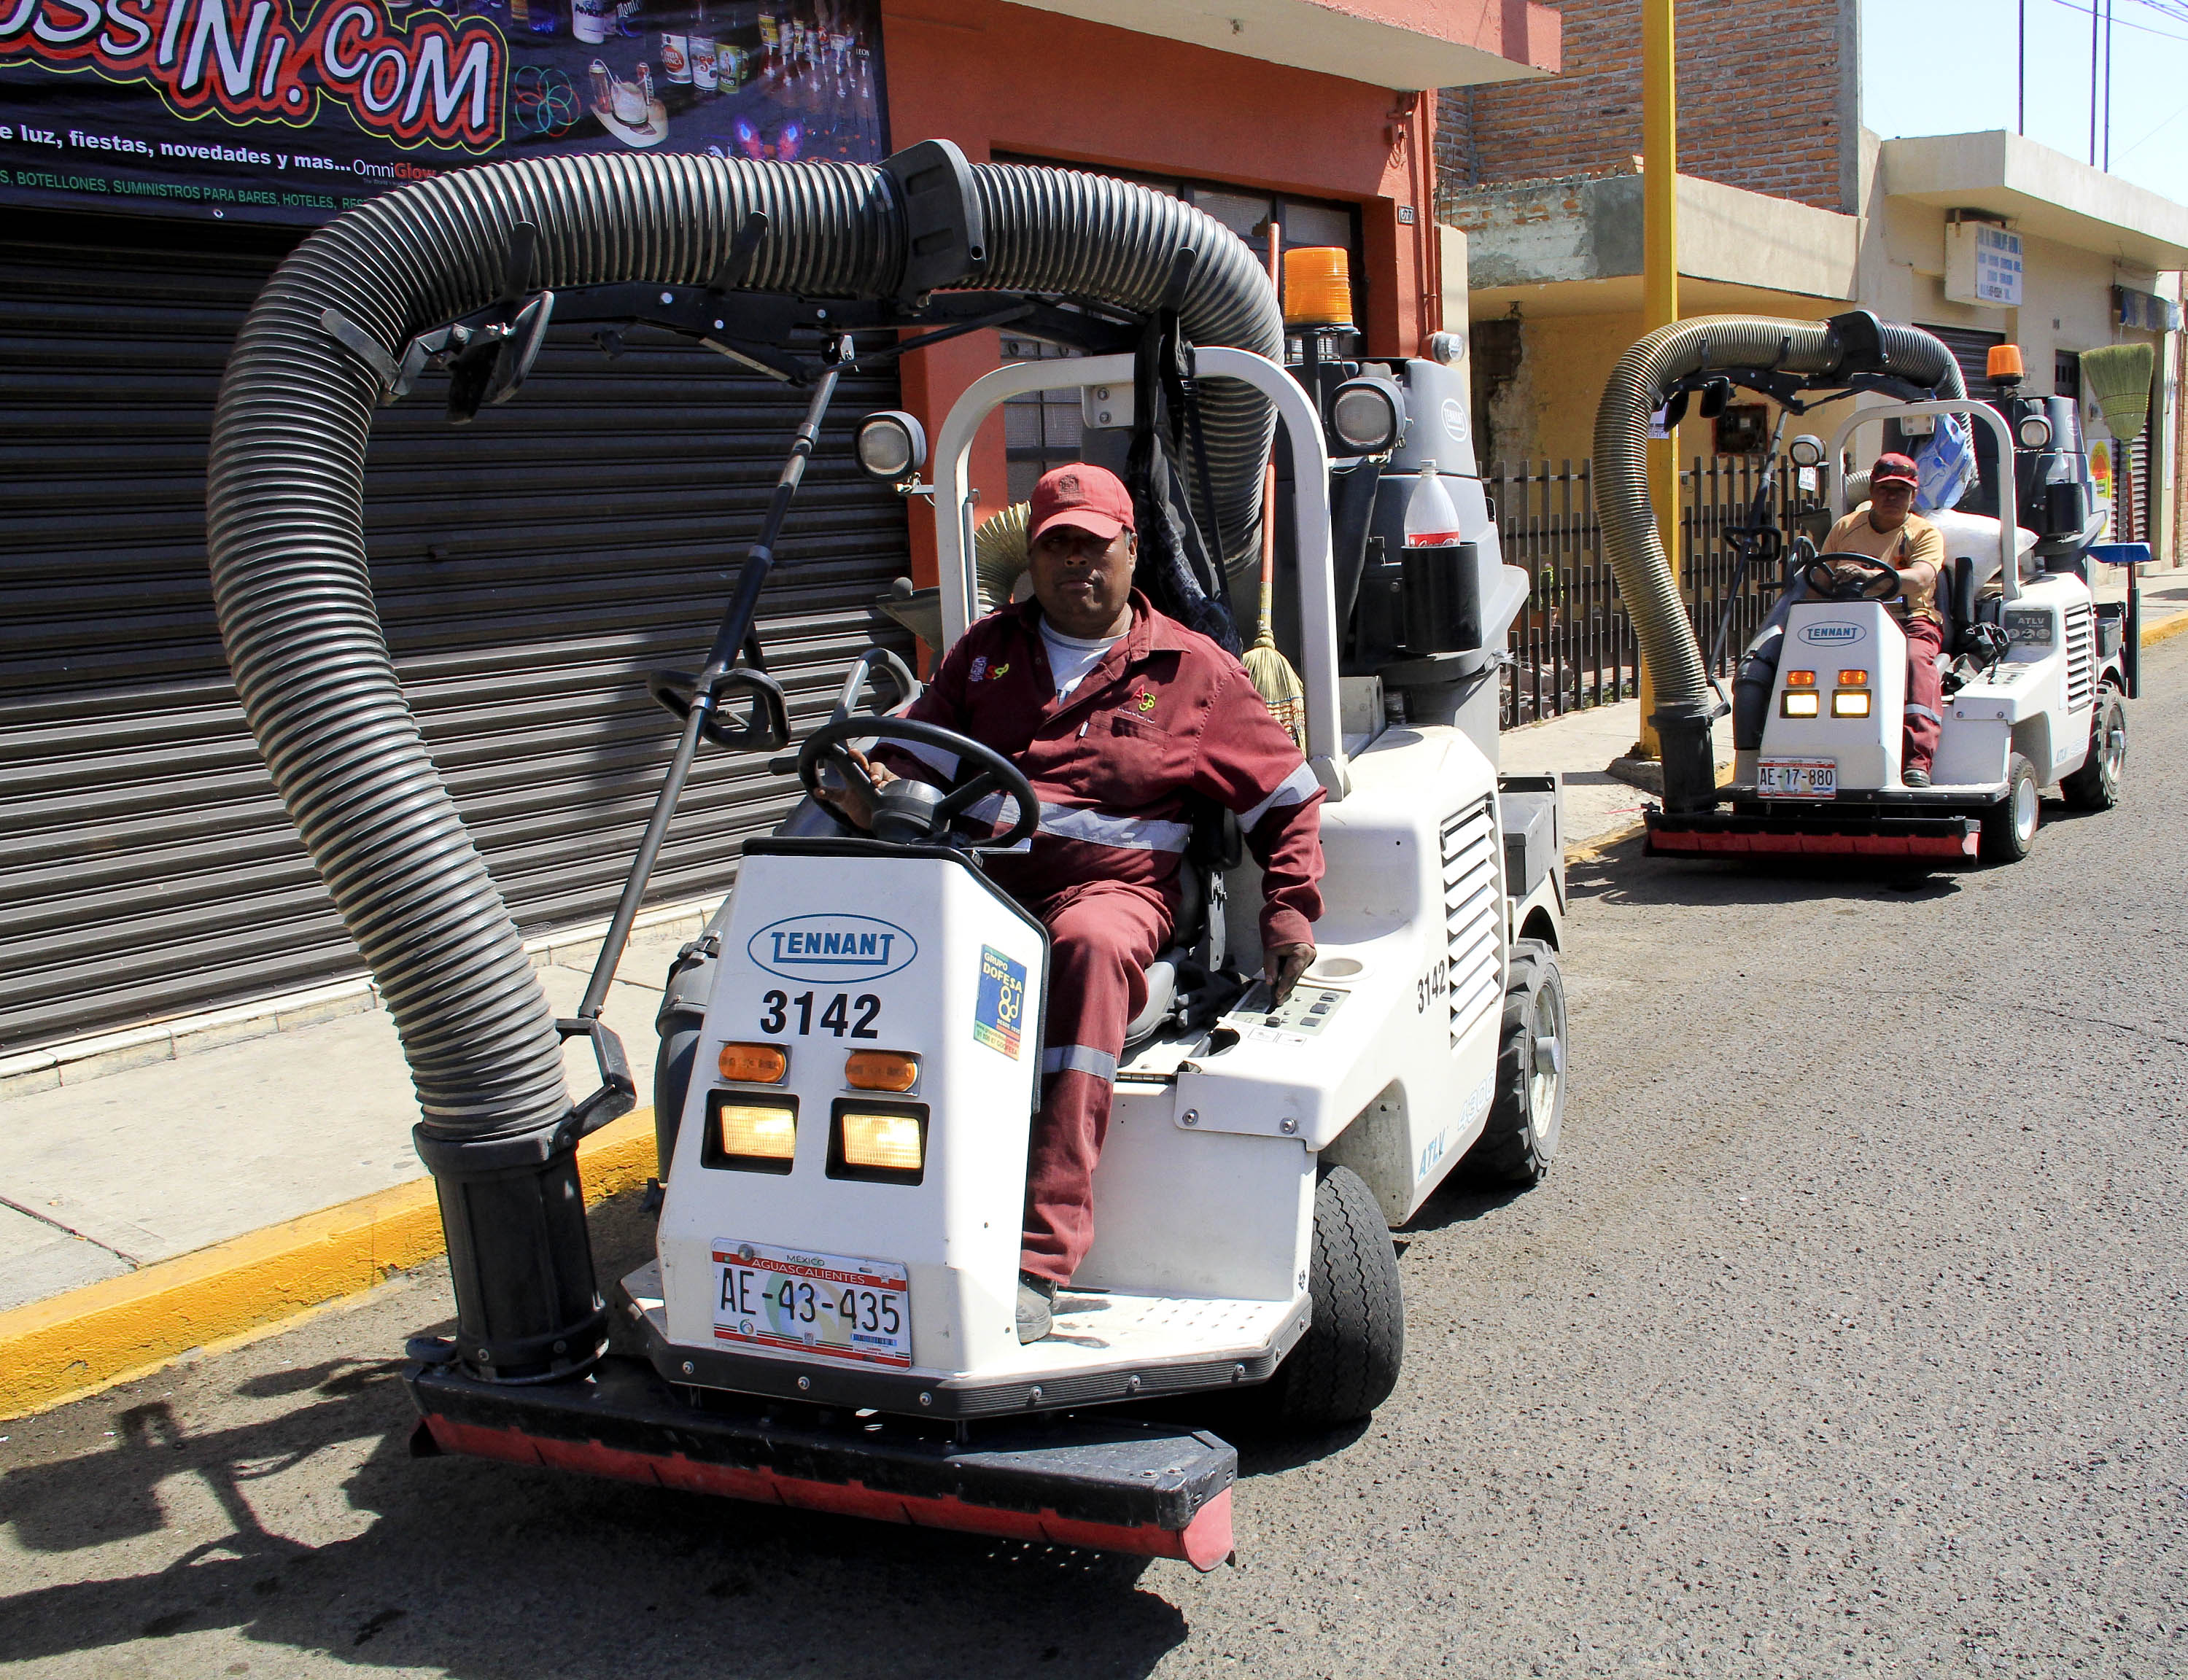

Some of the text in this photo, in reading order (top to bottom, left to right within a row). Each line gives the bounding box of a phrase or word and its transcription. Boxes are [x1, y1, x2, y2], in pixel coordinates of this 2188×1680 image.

[20, 124, 62, 149] luz,
[69, 129, 154, 158] fiestas,
[160, 142, 271, 165] novedades
[276, 153, 288, 169] y
[294, 155, 351, 171] mas...
[17, 171, 110, 193] BOTELLONES,
[114, 180, 200, 200] SUMINISTROS
[203, 187, 236, 202] PARA
[238, 190, 280, 207] BARES,
[282, 193, 337, 210] HOTELES,
[1807, 628, 1858, 640] TENNANT
[1760, 768, 1833, 785] AE-17-880
[770, 932, 896, 965] TENNANT
[984, 952, 1008, 971] GRUPO
[983, 962, 1023, 993] DOFESA
[1417, 959, 1446, 1014] 3142
[761, 989, 881, 1038] 3142
[1418, 1068, 1495, 1182] ATLV 4300
[751, 1259, 865, 1285] AGUASCALIENTES
[721, 1268, 899, 1335] AE-43-435
